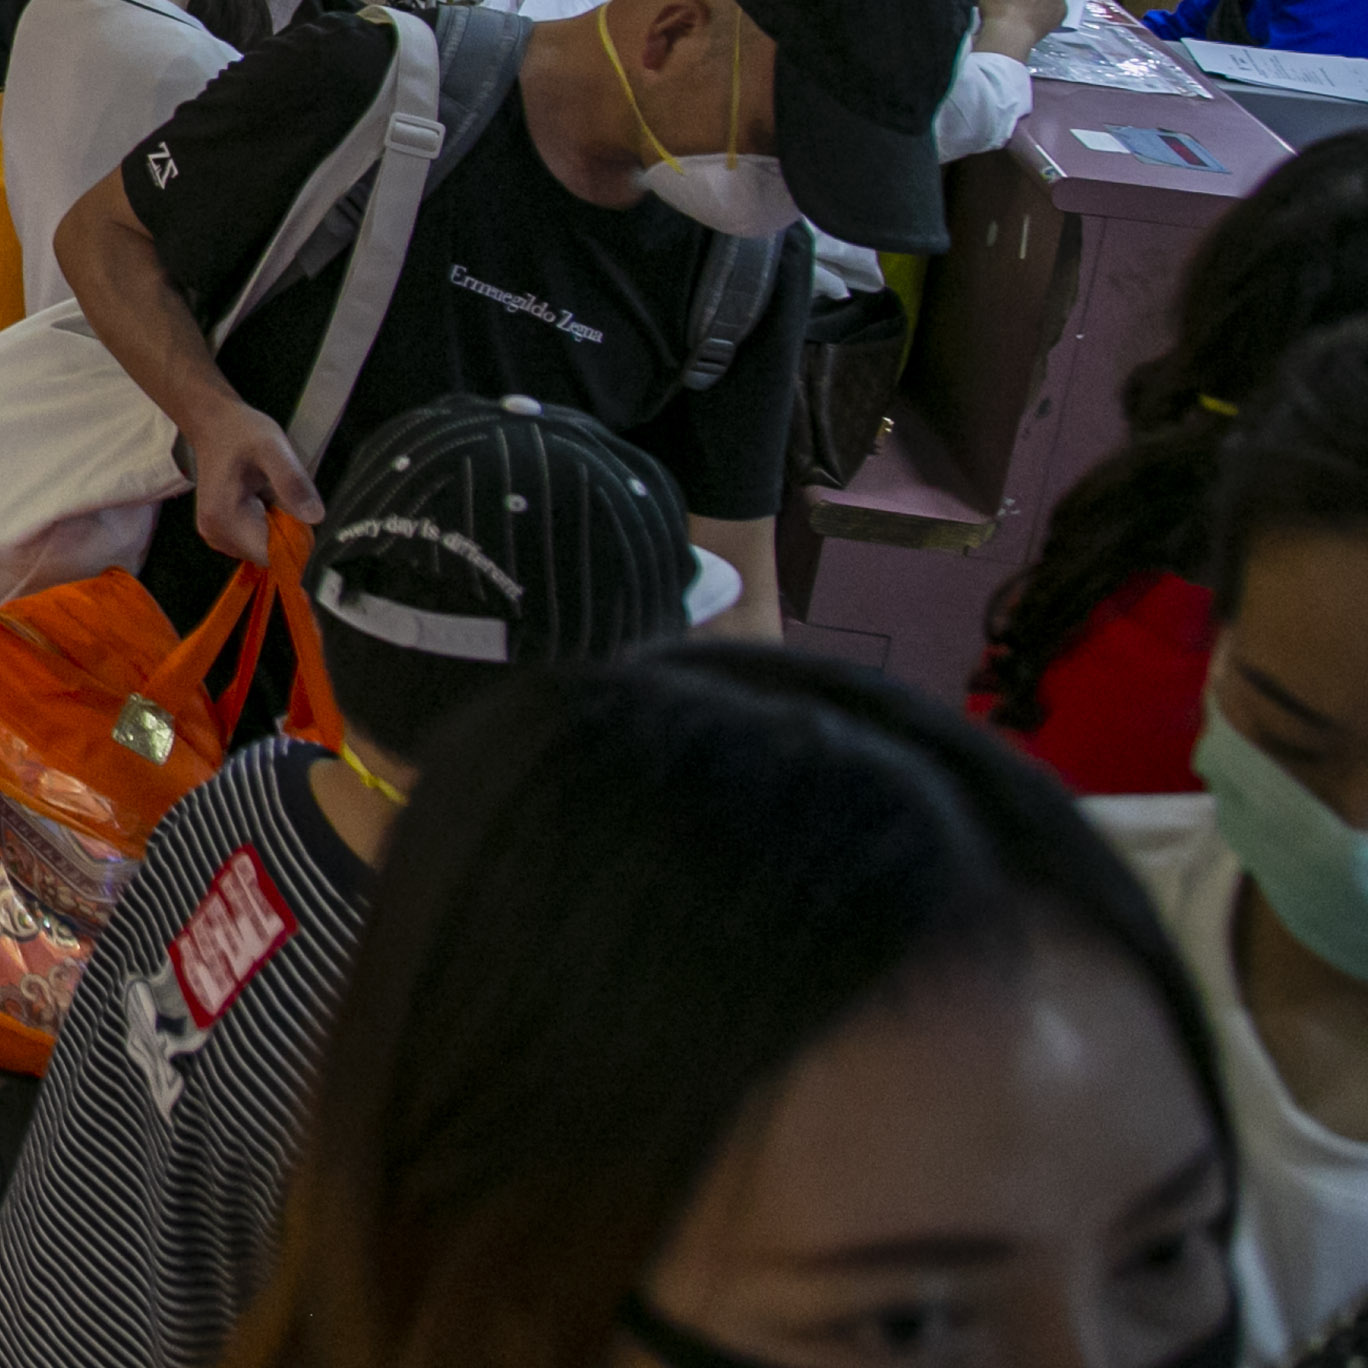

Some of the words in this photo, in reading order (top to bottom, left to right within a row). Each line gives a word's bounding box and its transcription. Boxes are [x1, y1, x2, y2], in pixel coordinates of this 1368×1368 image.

[450, 264, 556, 322] Ermenegildo
[556, 309, 604, 344] Zegna
[337, 520, 382, 543] every
[383, 514, 418, 538] day
[420, 518, 440, 540] is
